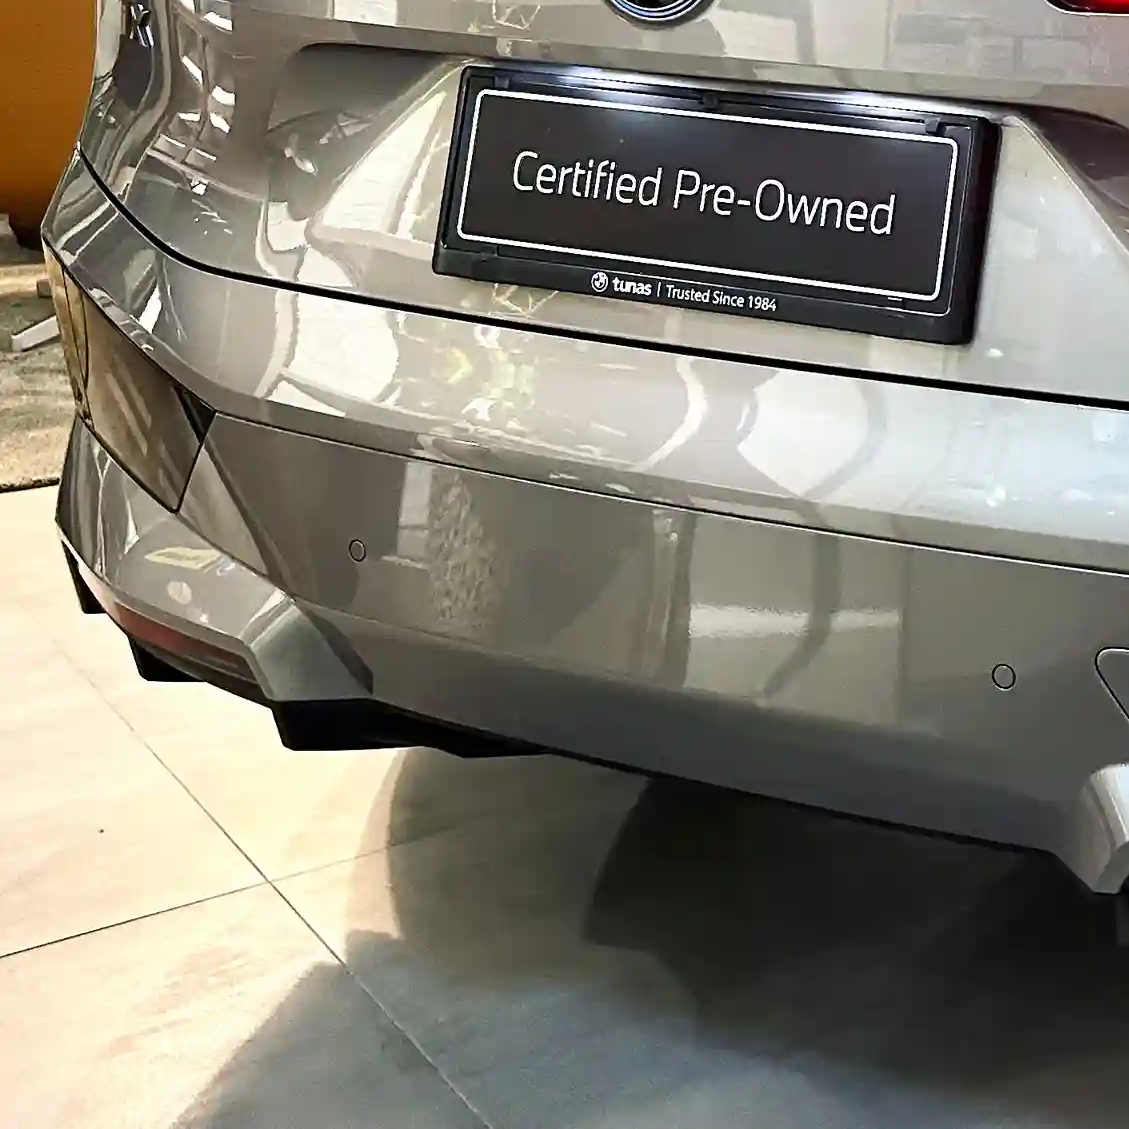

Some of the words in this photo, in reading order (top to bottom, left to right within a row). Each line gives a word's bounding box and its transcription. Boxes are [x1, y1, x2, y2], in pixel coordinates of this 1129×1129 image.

[512, 150, 663, 207] Certified
[673, 168, 897, 235] Pre-Owned
[612, 276, 652, 297] tunas
[666, 284, 711, 303] Trusted
[712, 291, 745, 308] Since
[748, 295, 777, 312] 1984
